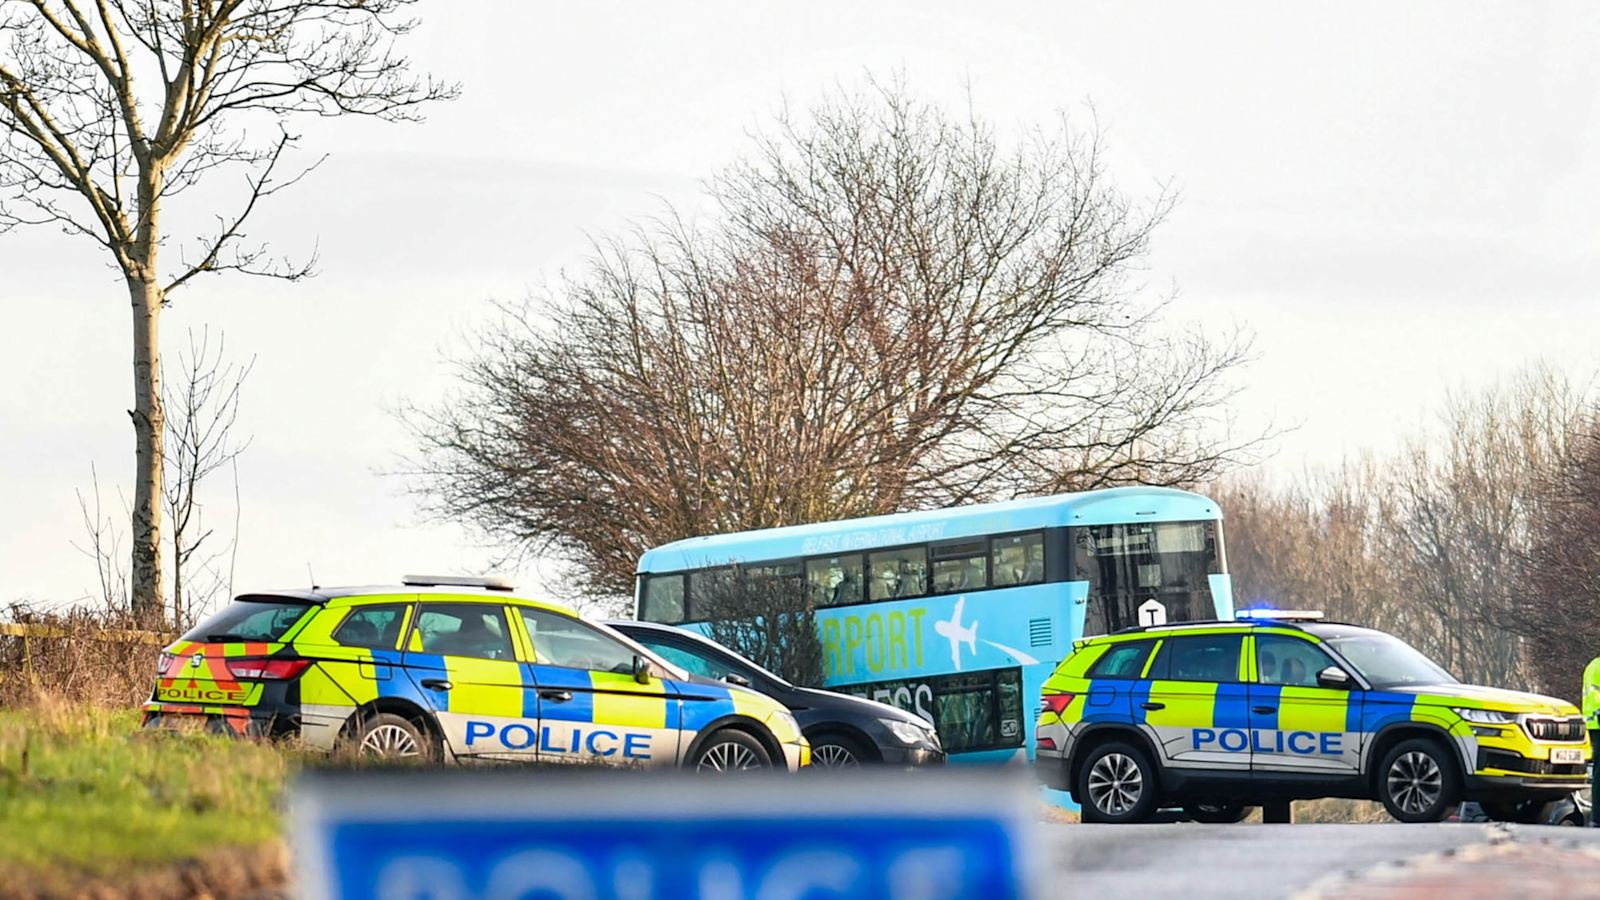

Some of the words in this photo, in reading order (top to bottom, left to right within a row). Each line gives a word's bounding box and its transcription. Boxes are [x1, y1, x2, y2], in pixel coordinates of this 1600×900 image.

[820, 607, 926, 677] RPORT
[158, 688, 246, 701] POLICE
[465, 721, 652, 759] POLICE
[1192, 728, 1344, 755] POLICE
